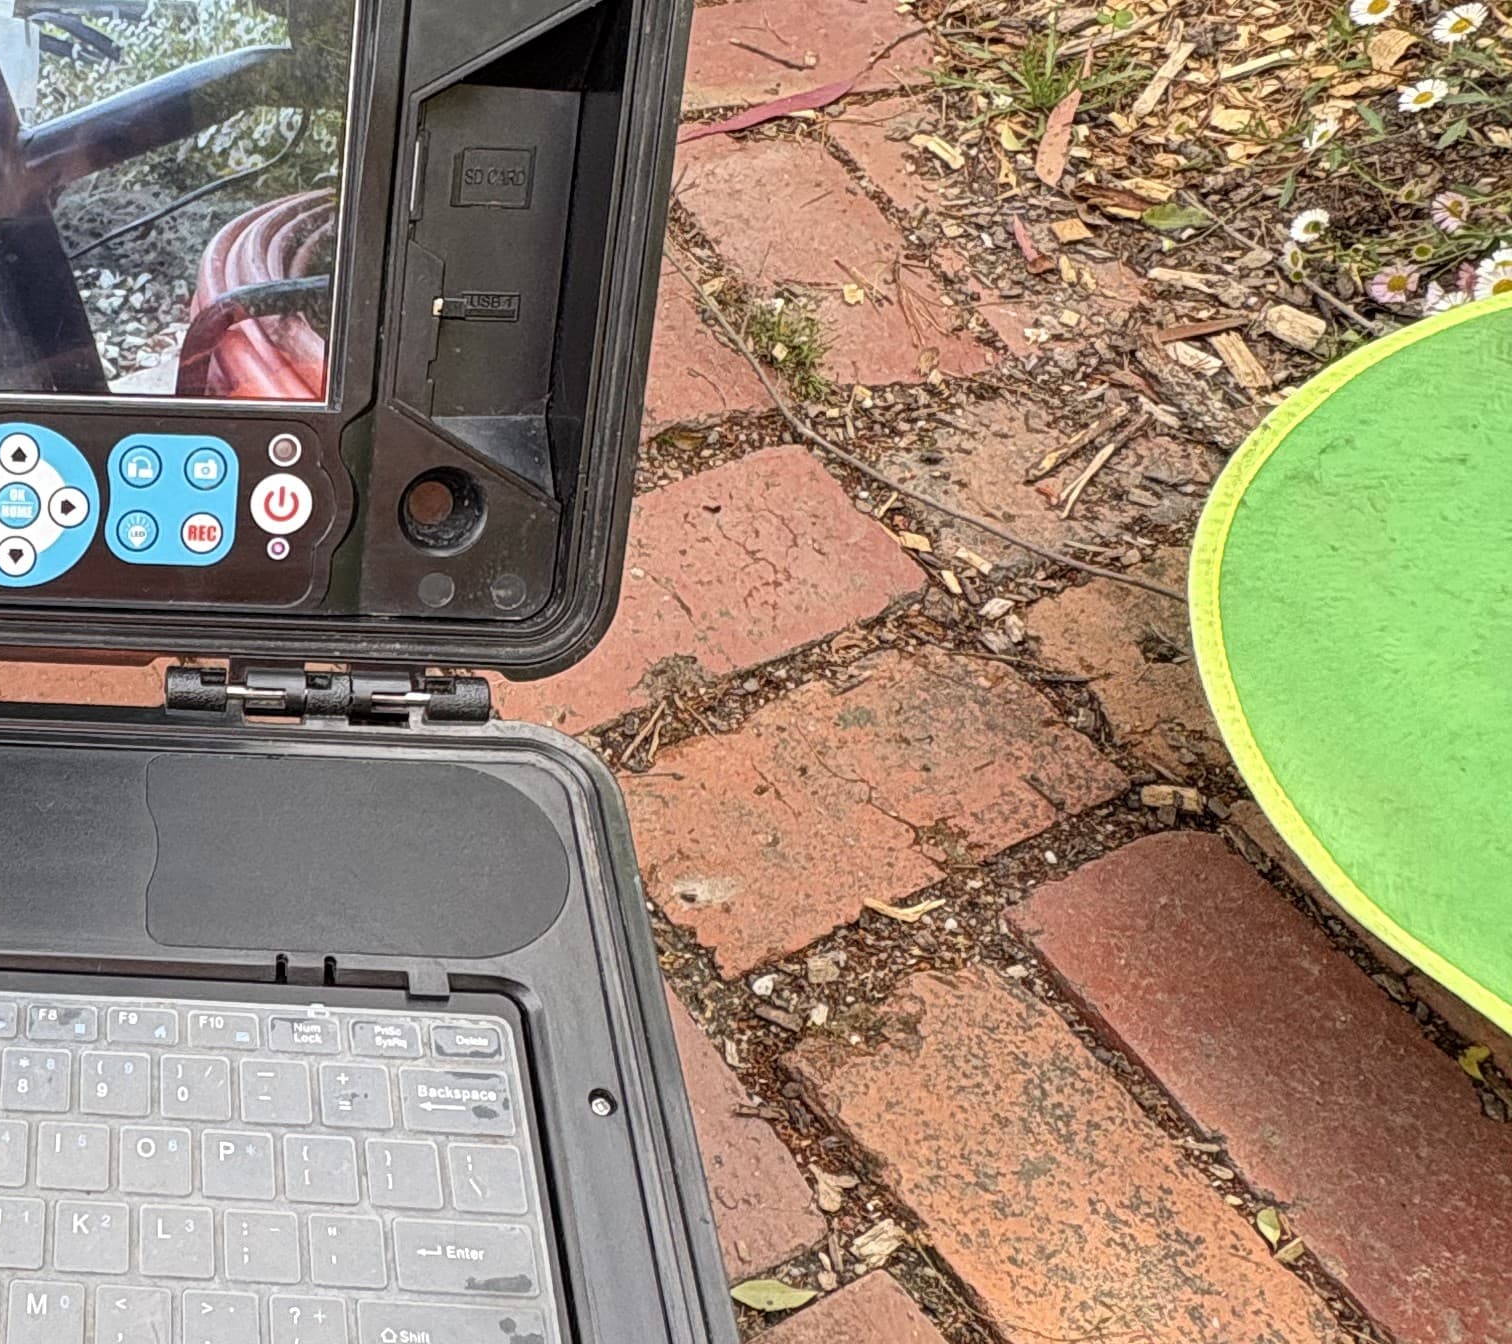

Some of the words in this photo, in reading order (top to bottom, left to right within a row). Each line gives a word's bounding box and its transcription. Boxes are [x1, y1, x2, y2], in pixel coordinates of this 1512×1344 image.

[465, 168, 484, 185] SD
[488, 169, 526, 186] CARD
[468, 296, 501, 308] USB
[9, 488, 26, 502] OK
[0, 504, 34, 519] HOME
[130, 530, 146, 539] LED
[187, 525, 217, 542] REC
[38, 1009, 58, 1021] F8
[118, 1012, 138, 1025] F9
[199, 1016, 224, 1029] F10
[293, 1022, 321, 1033] Num
[294, 1033, 322, 1044] Lock
[456, 1035, 489, 1046] Delete
[46, 1058, 55, 1070] 8
[97, 1060, 103, 1075] (
[124, 1062, 134, 1074] 9
[177, 1064, 183, 1078] )
[17, 1079, 29, 1093] 8
[337, 1073, 349, 1085] +
[97, 1083, 108, 1098] 9
[177, 1087, 189, 1102] 0
[417, 1085, 497, 1101] Backspace
[1, 1131, 10, 1143] 4
[55, 1133, 61, 1153] I
[137, 1138, 156, 1157] O
[219, 1142, 235, 1161] P
[72, 1214, 89, 1234] K
[101, 1215, 112, 1228] 2
[157, 1218, 171, 1239] L
[184, 1219, 194, 1232] 3
[446, 1245, 485, 1261] Enter
[26, 1293, 47, 1315] M
[60, 1296, 70, 1309] 0
[115, 1297, 127, 1309] <
[200, 1302, 213, 1314] >
[289, 1307, 301, 1324] ?
[313, 1309, 326, 1324] +
[399, 1331, 430, 1344] Shift
